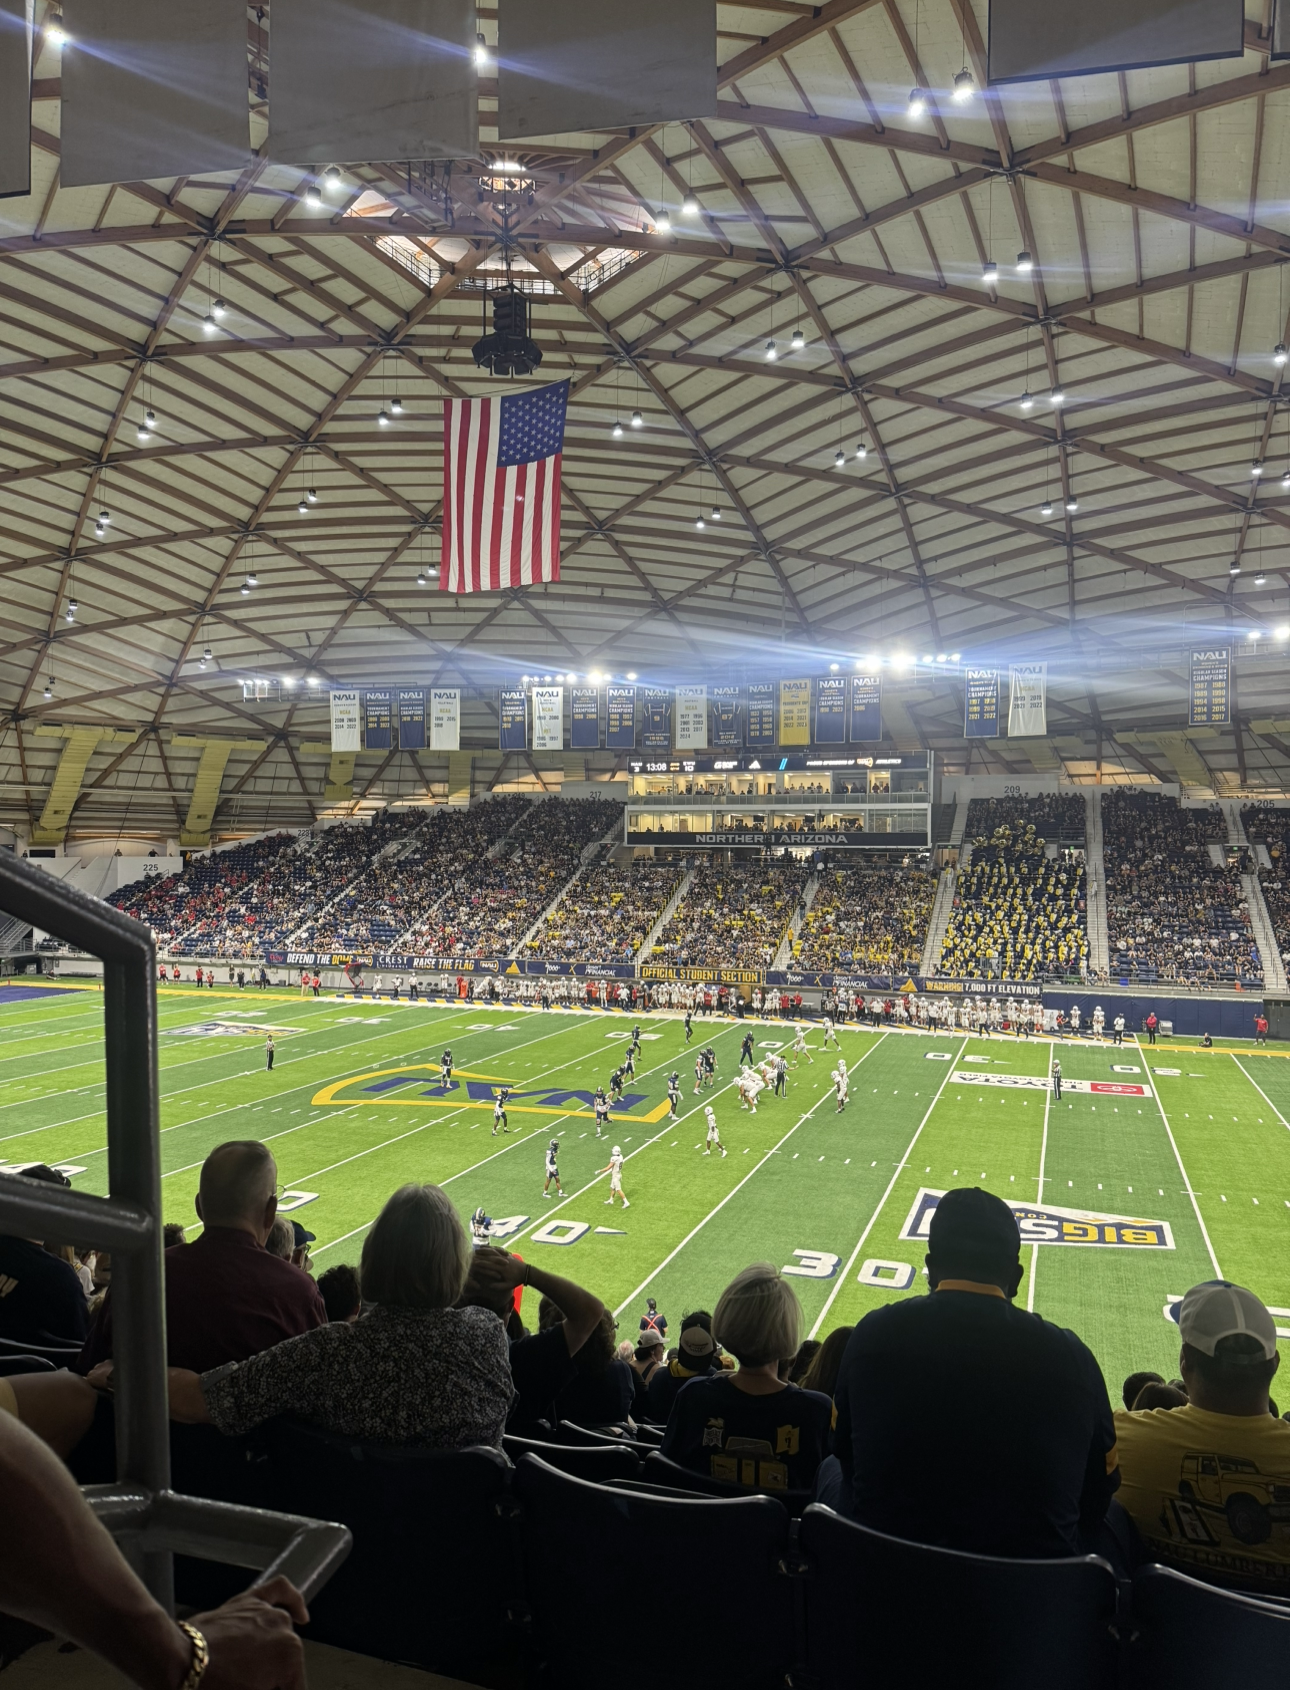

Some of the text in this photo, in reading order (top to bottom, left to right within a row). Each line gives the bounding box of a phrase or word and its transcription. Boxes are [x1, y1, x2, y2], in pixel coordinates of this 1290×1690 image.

[1193, 651, 1226, 660] NAU
[1014, 666, 1042, 674] NAU
[783, 682, 807, 690] NAU
[819, 680, 844, 688] NAU
[854, 678, 879, 686] NAU
[646, 763, 666, 771] 13:08
[1257, 800, 1275, 809] 205
[779, 835, 848, 843] ARIZONA
[287, 953, 314, 964] DEFEND
[317, 953, 331, 964] THE
[413, 957, 474, 970] RAISE THE FLAG
[643, 967, 757, 982] OFFICIAL STUDENT SECTION
[926, 982, 1040, 994] WARNING 7,000 FT ELEVATION
[958, 1076, 1083, 1091] TOYOTA
[360, 1076, 650, 1112] NAU
[490, 1214, 592, 1246] 40
[781, 1248, 917, 1291] 30
